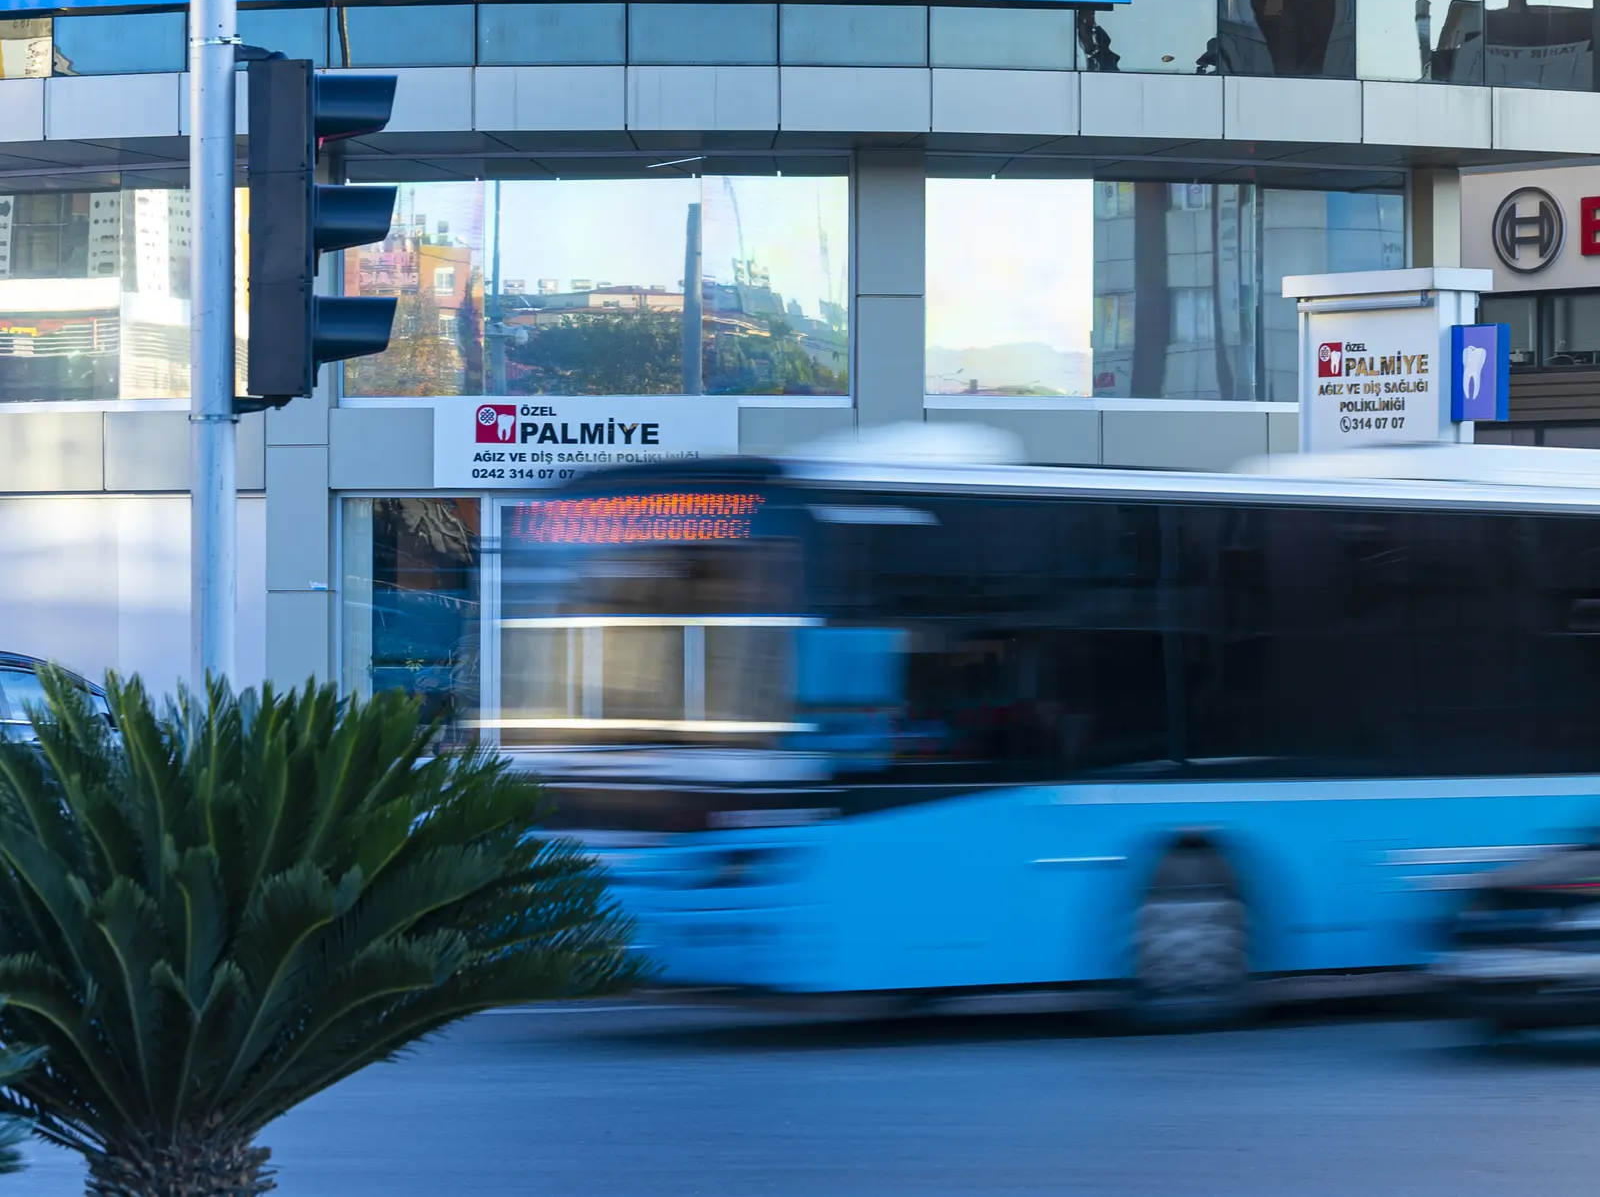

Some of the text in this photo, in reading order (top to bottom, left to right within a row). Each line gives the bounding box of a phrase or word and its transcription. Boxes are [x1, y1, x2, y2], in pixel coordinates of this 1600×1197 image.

[1345, 342, 1367, 352] ÖZEL
[1345, 351, 1429, 376] PALMİYE
[1318, 379, 1428, 396] AĞIZ VE DİŞ SAĞLIĞI
[520, 404, 556, 417] ÖZEL
[1340, 397, 1405, 412] POLİKLİNİĞİ
[520, 417, 659, 444] PALMİYE
[1352, 417, 1405, 430] 314 07 07
[473, 450, 505, 462] AĞIZ
[509, 452, 526, 462] VE
[531, 450, 553, 465] DİŞ
[557, 450, 612, 463] SAĞLIĞI
[472, 468, 576, 479] 0242 314 07 07
